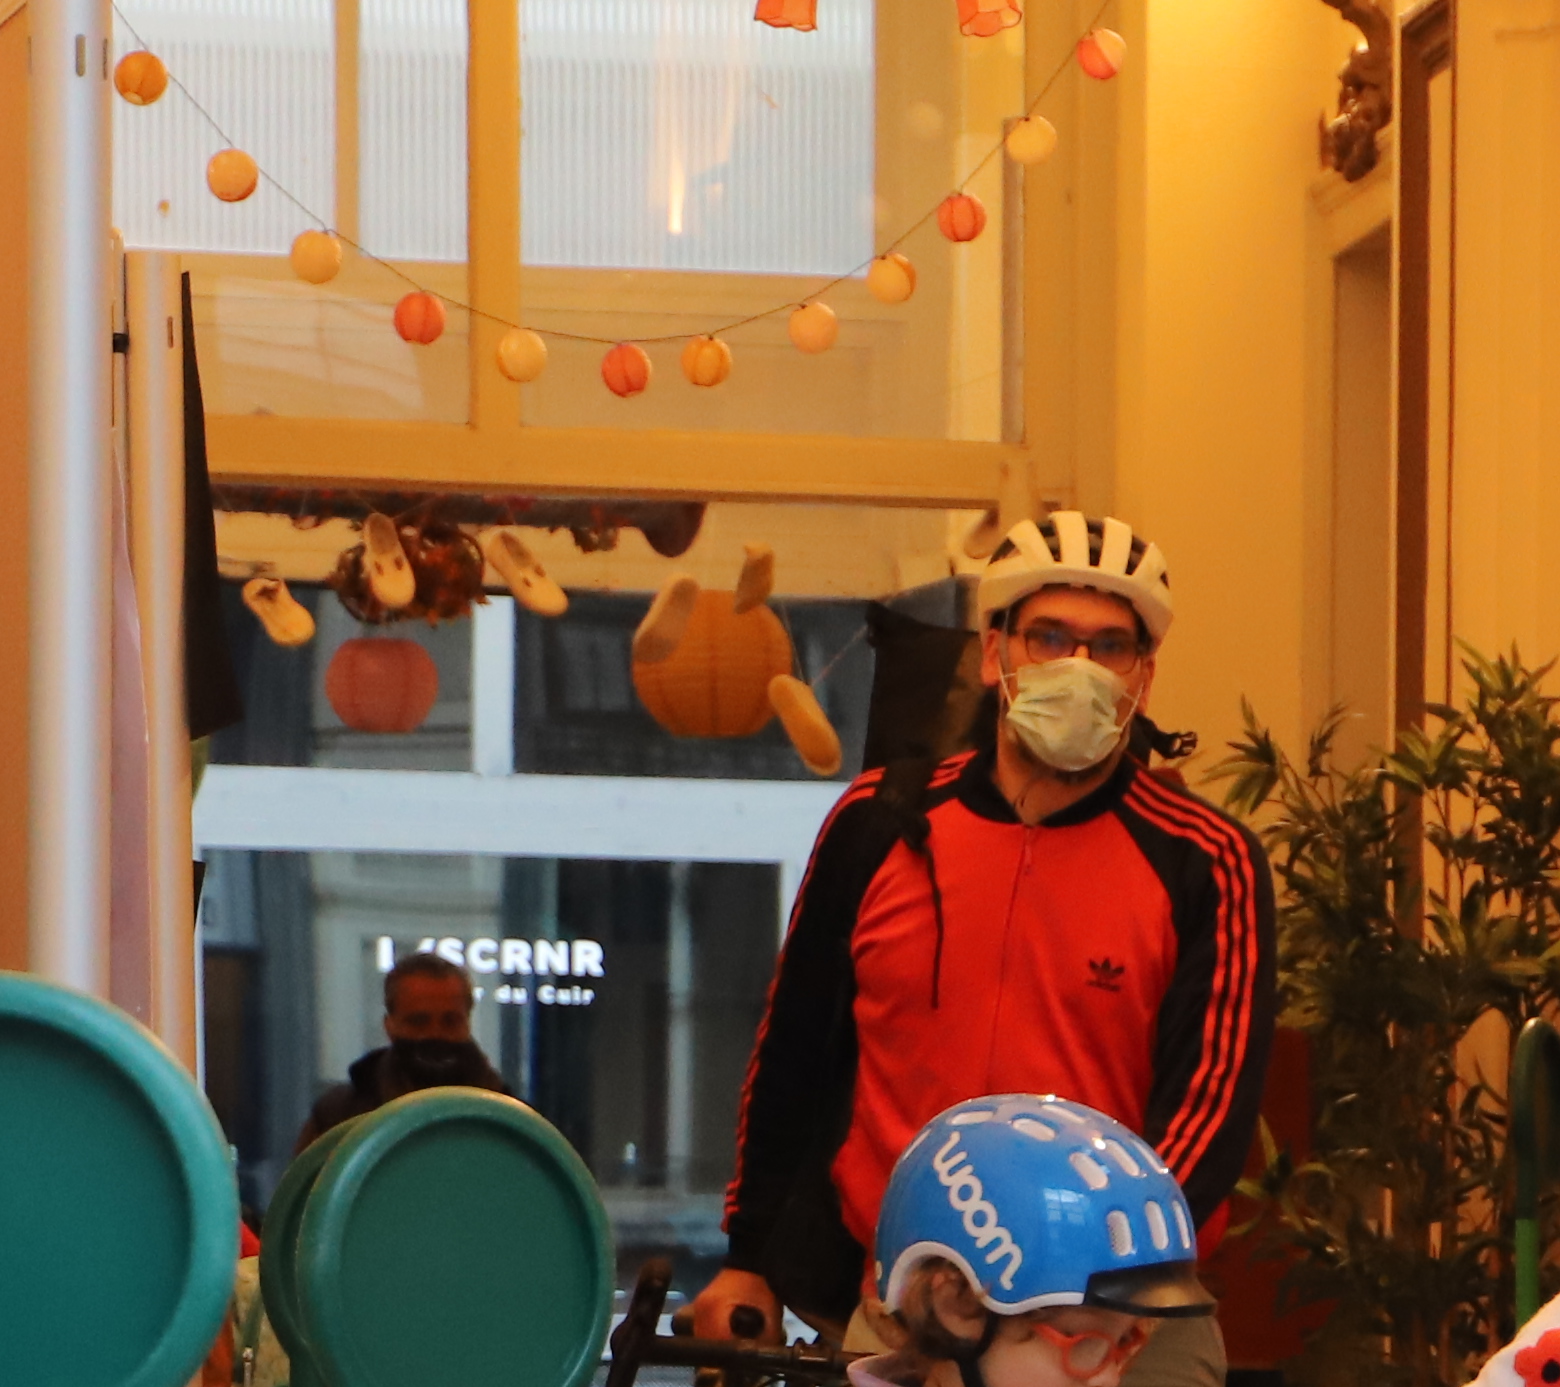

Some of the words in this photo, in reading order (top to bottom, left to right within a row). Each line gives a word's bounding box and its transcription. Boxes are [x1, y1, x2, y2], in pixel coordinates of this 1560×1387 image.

[493, 984, 529, 1005] du
[536, 984, 596, 1006] Cuir
[932, 1130, 1023, 1291] woom
